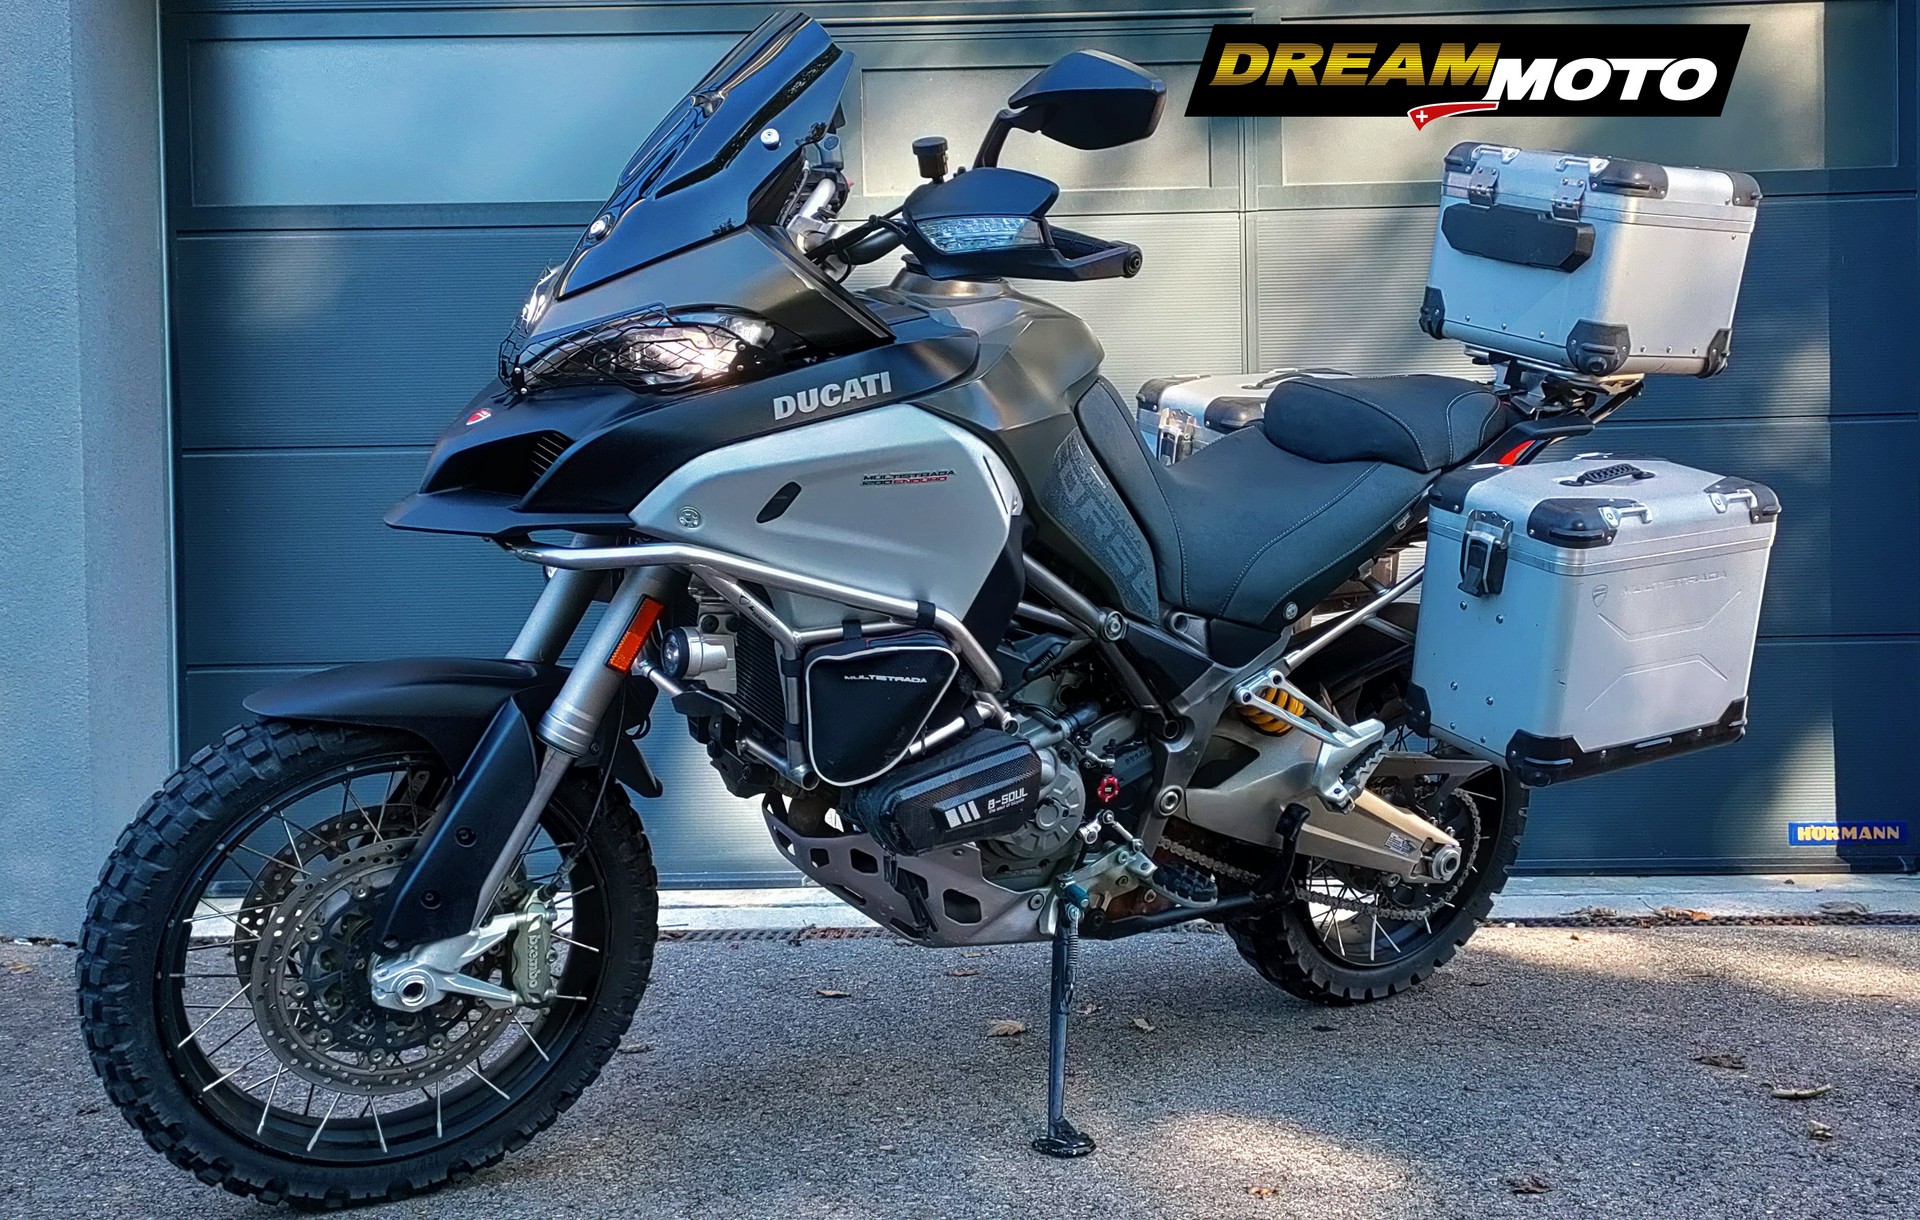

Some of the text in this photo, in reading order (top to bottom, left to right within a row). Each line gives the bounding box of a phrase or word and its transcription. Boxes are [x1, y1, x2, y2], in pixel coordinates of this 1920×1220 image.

[773, 371, 892, 420] DUCATI
[863, 469, 956, 480] MULTISTRADA
[893, 476, 948, 484] ENDURO
[987, 787, 1028, 810] B-SOUL
[528, 934, 541, 989] brembo
